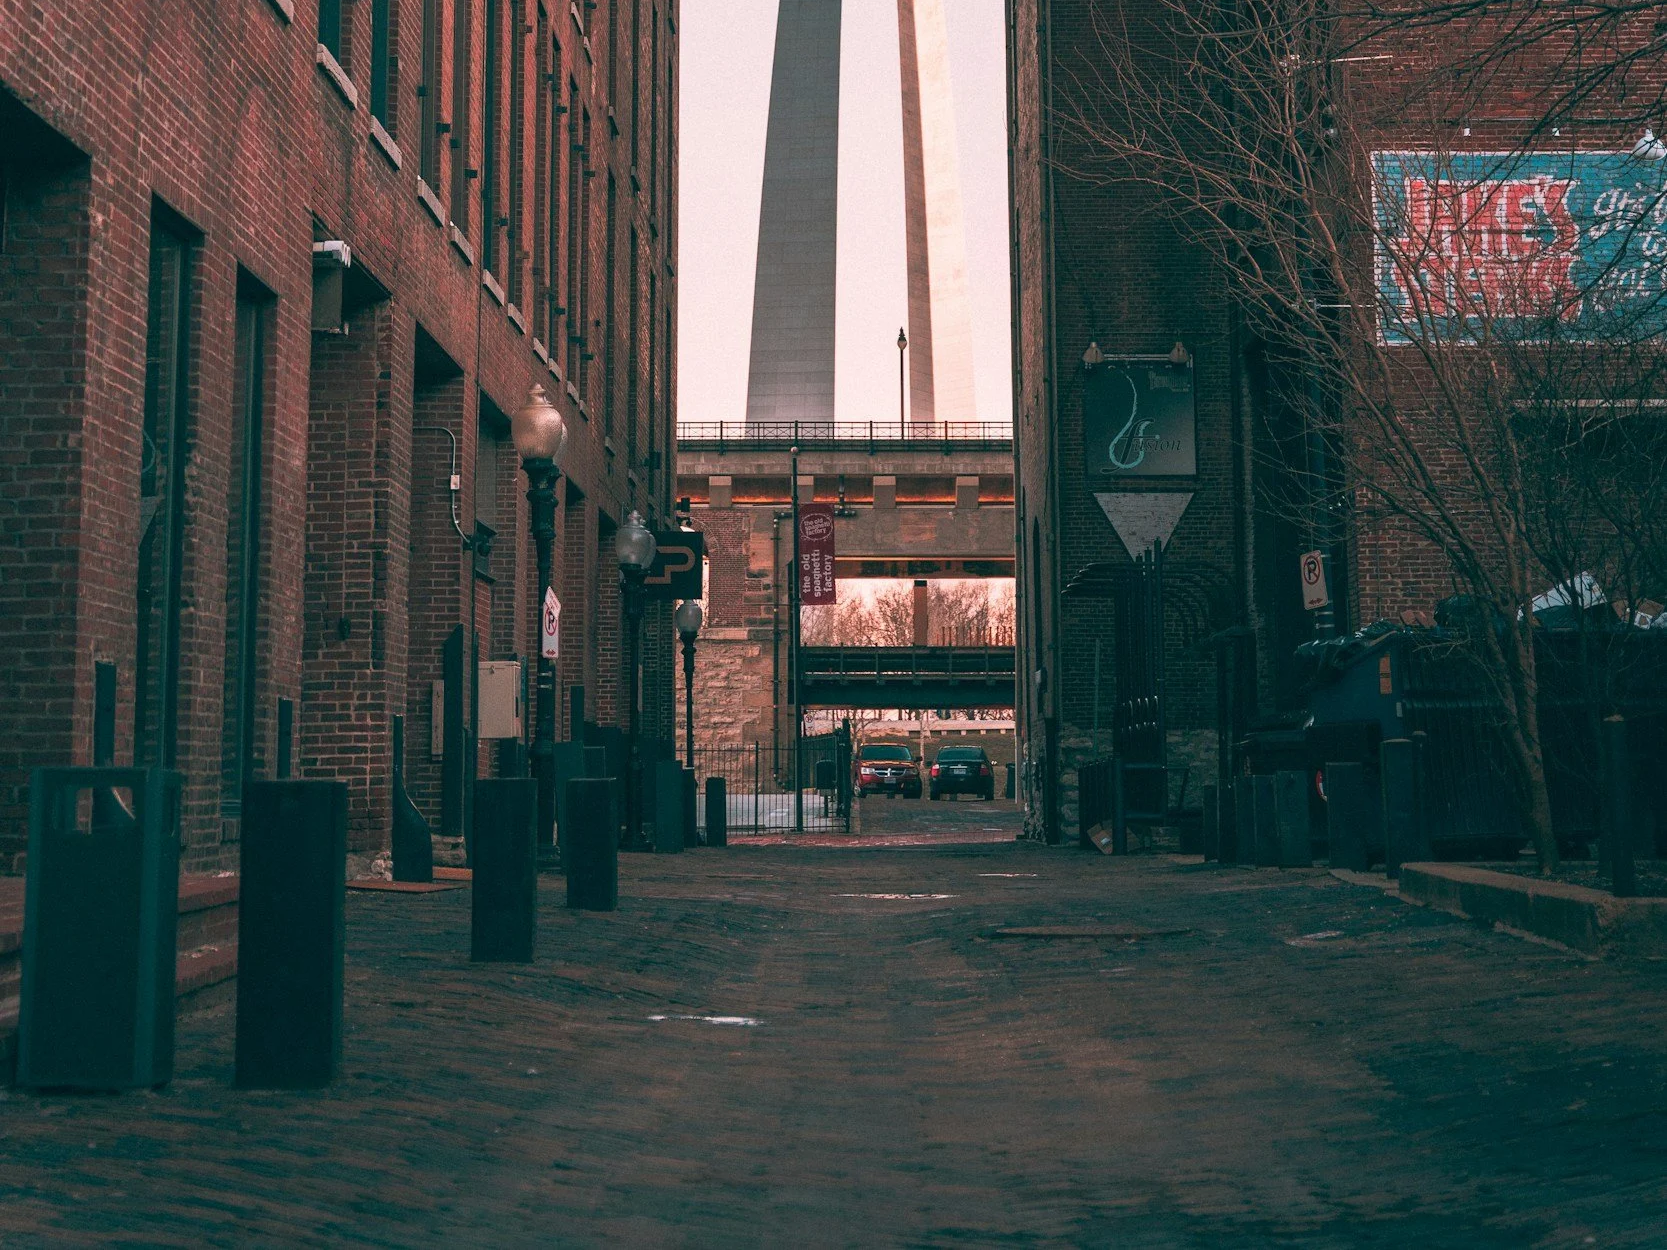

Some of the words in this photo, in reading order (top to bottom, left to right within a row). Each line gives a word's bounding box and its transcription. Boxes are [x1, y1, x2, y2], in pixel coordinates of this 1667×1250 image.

[801, 553, 810, 570] old
[811, 549, 822, 598] spaghetti
[823, 554, 834, 592] factory
[803, 575, 811, 593] the
